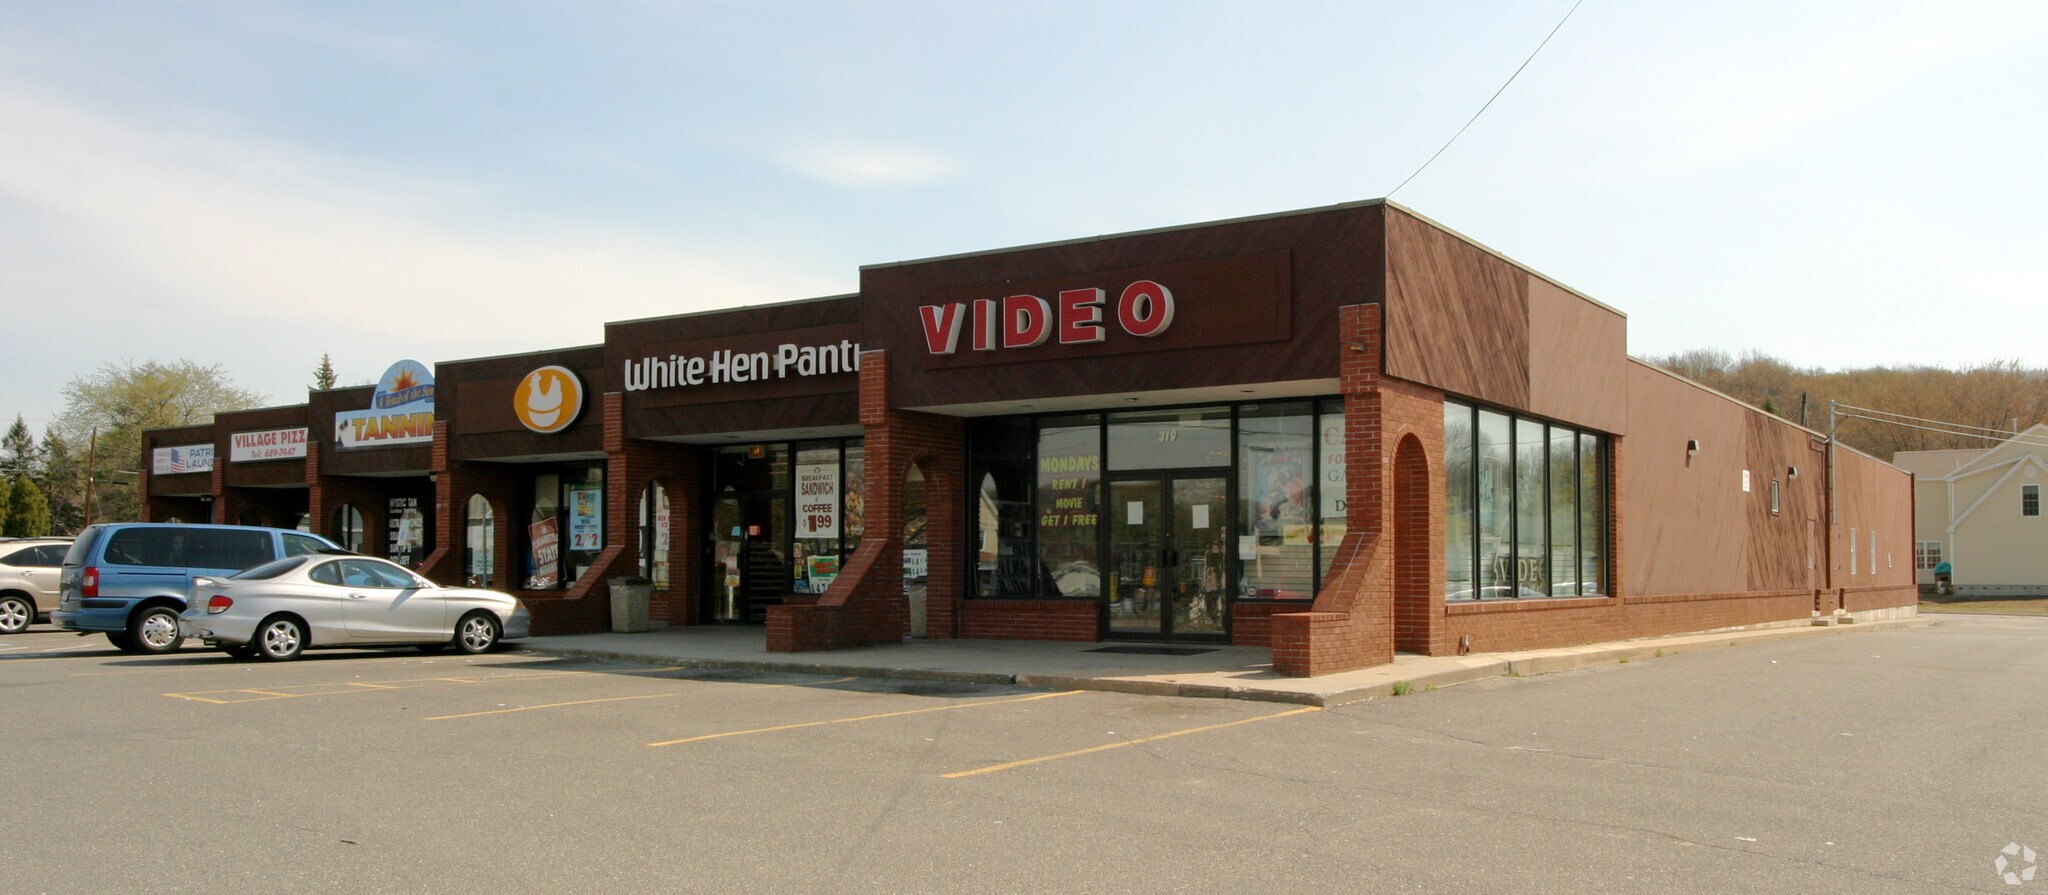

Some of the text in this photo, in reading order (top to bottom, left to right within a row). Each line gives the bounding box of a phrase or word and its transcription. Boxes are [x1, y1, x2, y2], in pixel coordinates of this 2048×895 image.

[918, 280, 1175, 355] VIDEO
[624, 355, 705, 391] White
[711, 349, 769, 384] Hen
[235, 430, 306, 448] VILLAGE PIZZ
[1158, 430, 1177, 442] 319
[1039, 455, 1099, 473] MONDAYS
[801, 474, 833, 482] BREAKFAST
[1051, 478, 1079, 491] RENT
[801, 481, 834, 496] SANDWICH
[802, 504, 832, 513] COFFEE
[1055, 497, 1083, 509] MOVIE
[1041, 515, 1061, 526] GET
[1071, 514, 1098, 526] FREE
